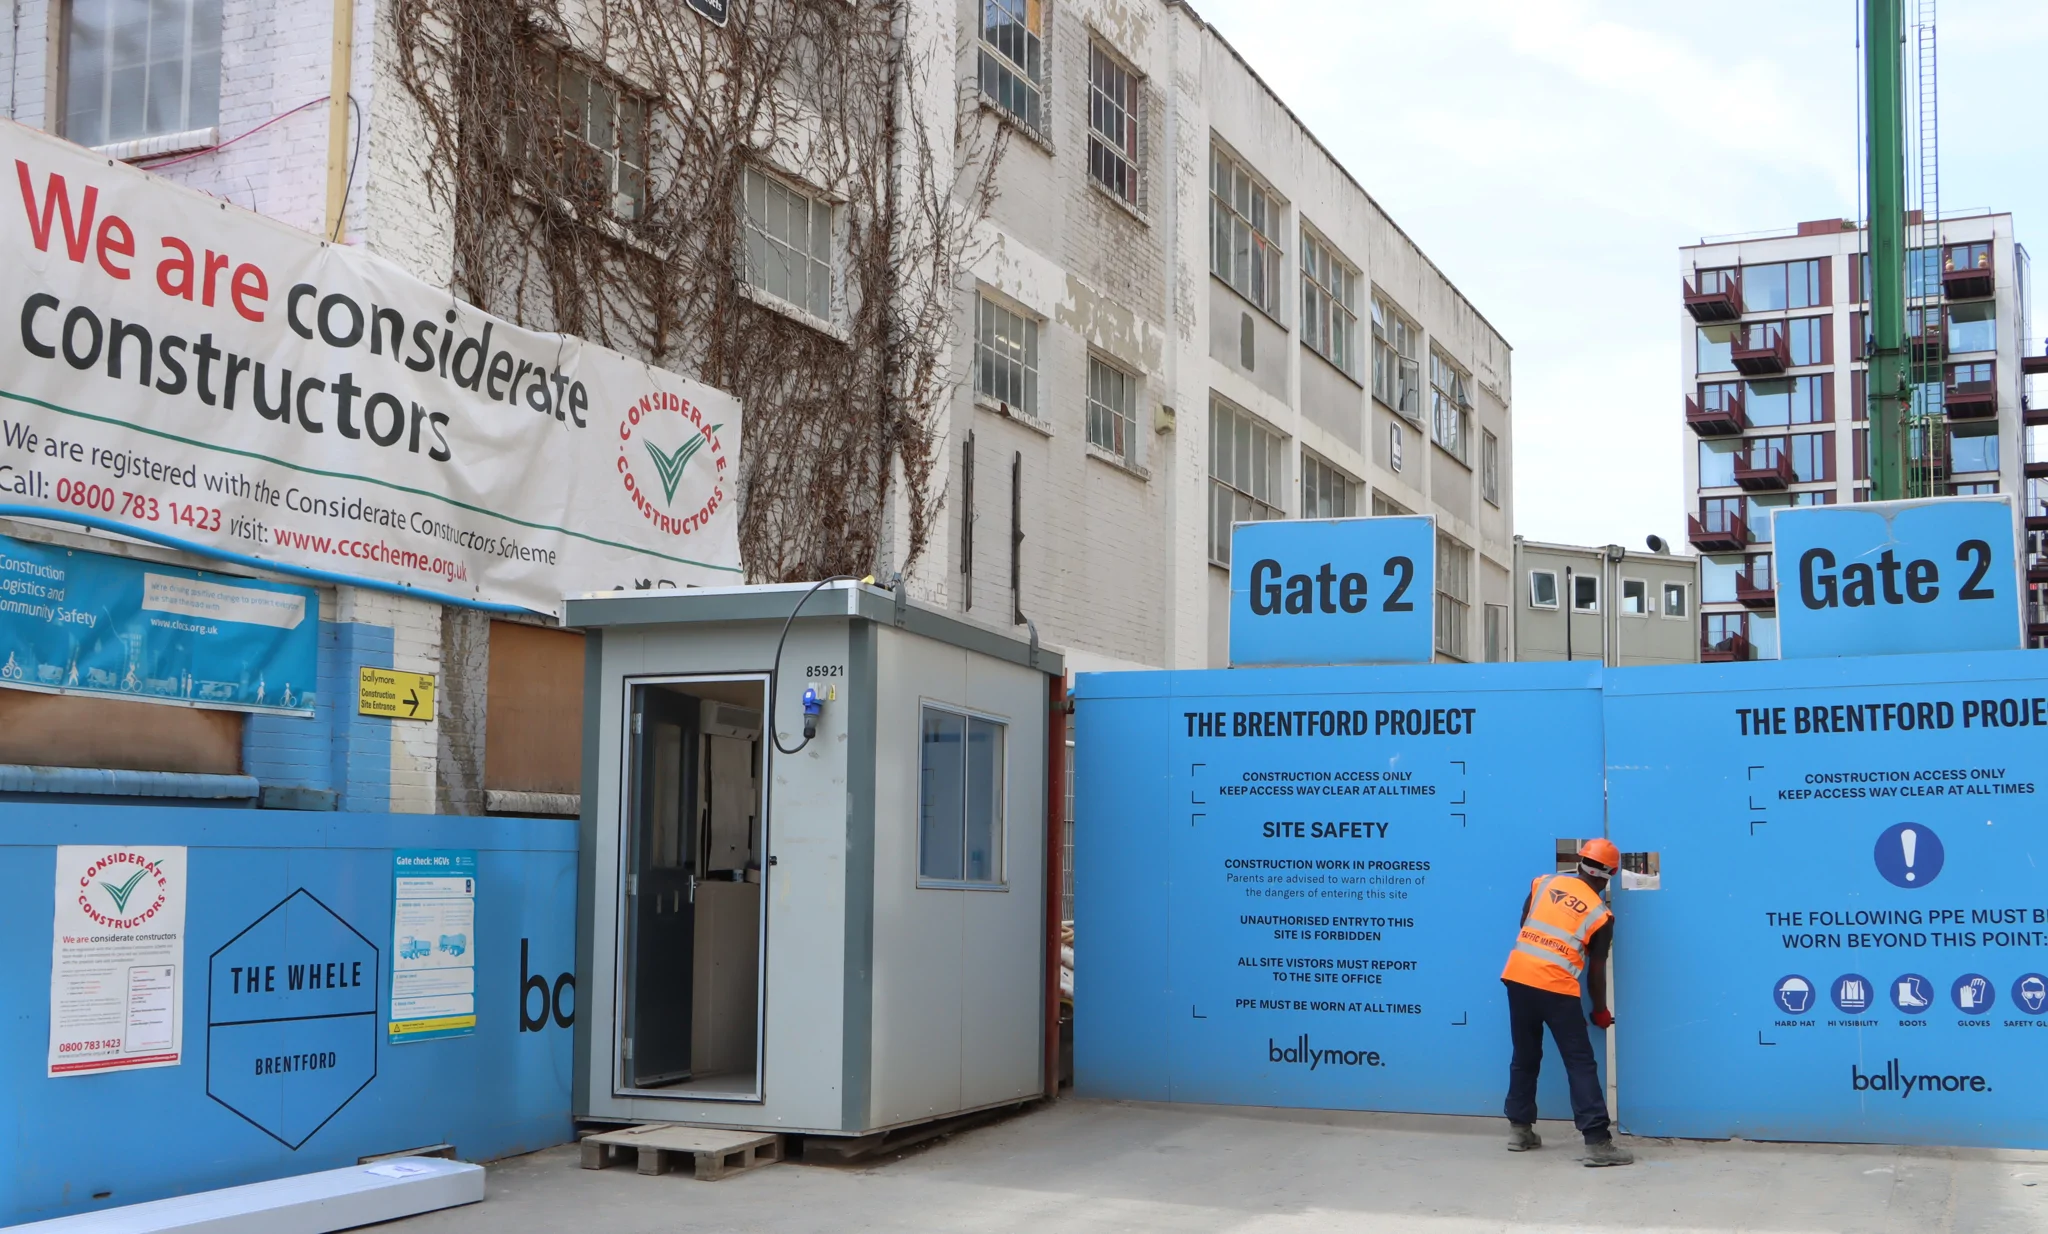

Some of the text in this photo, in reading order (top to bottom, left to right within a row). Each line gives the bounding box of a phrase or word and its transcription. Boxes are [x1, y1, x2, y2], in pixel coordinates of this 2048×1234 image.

[15, 159, 588, 429] We are considerate
[20, 292, 452, 462] constructors
[619, 391, 727, 473] CONSIDERATE
[3, 420, 556, 566] We are registered with the Considerate Constructors Scheme
[617, 455, 723, 536] CONSTRUCTORS
[0, 465, 467, 582] Call: 0800 783 1423 visit: www.ccscheme.org.uk
[0, 554, 65, 581] Construction
[1799, 539, 1994, 610] Gate 2
[47, 587, 65, 602] and
[1250, 555, 1414, 616] Gate 2
[0, 597, 97, 628] ommunity Safety
[806, 665, 844, 677] 85921
[361, 687, 396, 700] Construction
[361, 699, 396, 712] Site Entrance
[1184, 708, 1476, 737] THE BRENTFORD PROJECT
[1736, 707, 1787, 736] THE
[1794, 701, 1955, 734] BRENTFORD
[1242, 771, 1412, 782] CONSTRUCTION ACCESS ONLY
[1805, 768, 2006, 785] CONSTRUCTION ACCESS ONLY
[1219, 785, 1436, 796] KEEP ACCESS WAY CLEAR AT ALL TIMES
[1778, 783, 2035, 800] KEEP ACCESS WAY CLEAR AT ALL TIMES
[1262, 822, 1389, 838] SITE SAFETY
[80, 852, 167, 887] CONSIDERATE
[396, 856, 412, 866] Gate
[413, 856, 433, 866] check:
[1224, 859, 1431, 871] CONSTRUCTION WORK IN PROGRESS
[1226, 873, 1425, 885] Parents are advised to warn children of
[1246, 887, 1408, 900] the dangers of entering this site
[78, 894, 166, 929] CONSTRUCTORS
[1564, 895, 1588, 913] 3D
[1240, 915, 1414, 928] UNAUTHORISED ENTRY TO THIS
[1766, 908, 2048, 926] THE FOLLOWING PPE MUST B
[63, 932, 177, 944] We are considerate constructors
[1274, 930, 1381, 941] SITE IS FORBIDDEN
[1782, 931, 2048, 949] WORN BEYOND THIS POINT:
[1238, 957, 1417, 971] ALL SITE VISTORS MUST REPORT
[231, 965, 275, 994] THE
[288, 961, 362, 991] WHELE
[1273, 972, 1382, 984] TO THE SITE OFFICE
[1235, 998, 1422, 1014] PPE MUST BE WORN AT ALL TIMES
[59, 1038, 121, 1053] 0800 783 1423
[1269, 1033, 1386, 1071] ballymore.
[255, 1051, 337, 1076] BRENTFORD
[1852, 1058, 1992, 1099] ballymore.
